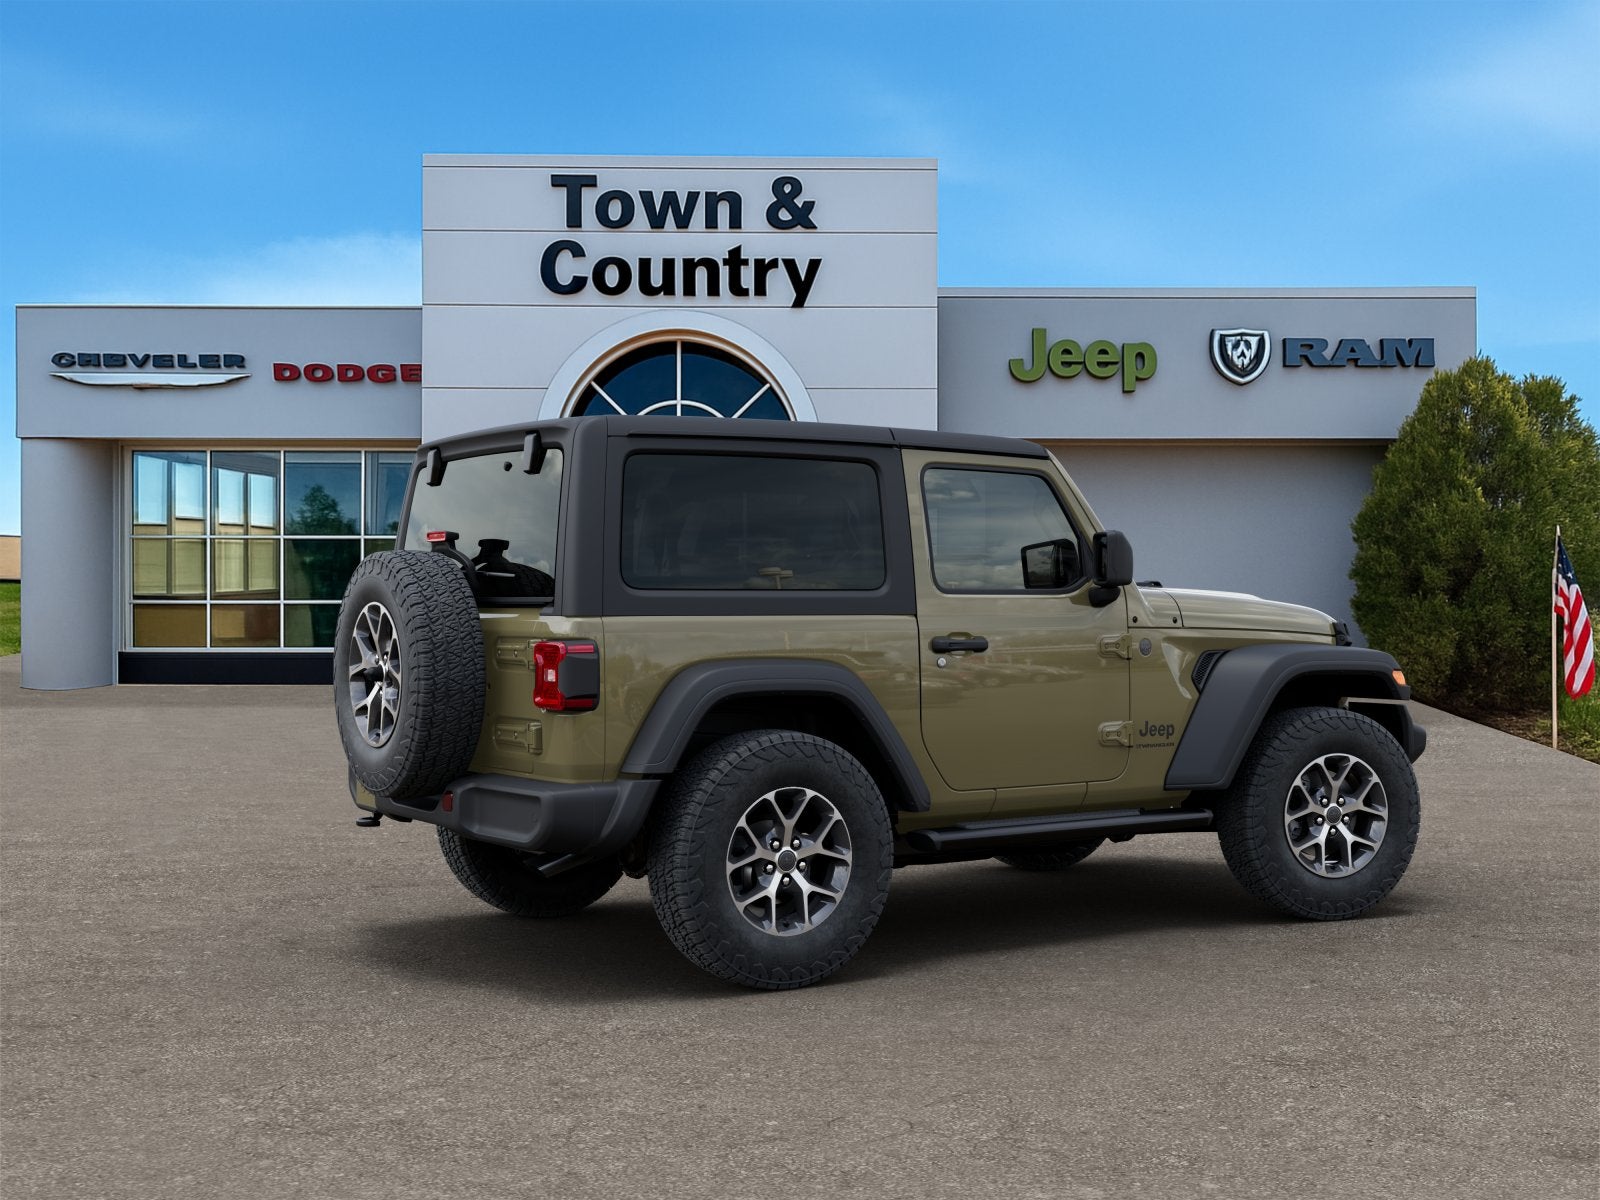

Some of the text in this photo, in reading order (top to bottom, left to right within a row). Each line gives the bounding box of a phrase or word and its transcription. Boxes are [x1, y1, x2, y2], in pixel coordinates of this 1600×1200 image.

[551, 174, 818, 230] Town &
[540, 239, 822, 308] Country
[273, 363, 422, 383] DODGE
[1009, 328, 1157, 393] Jeep
[1282, 338, 1435, 367] RAM
[1139, 720, 1175, 739] Jeep
